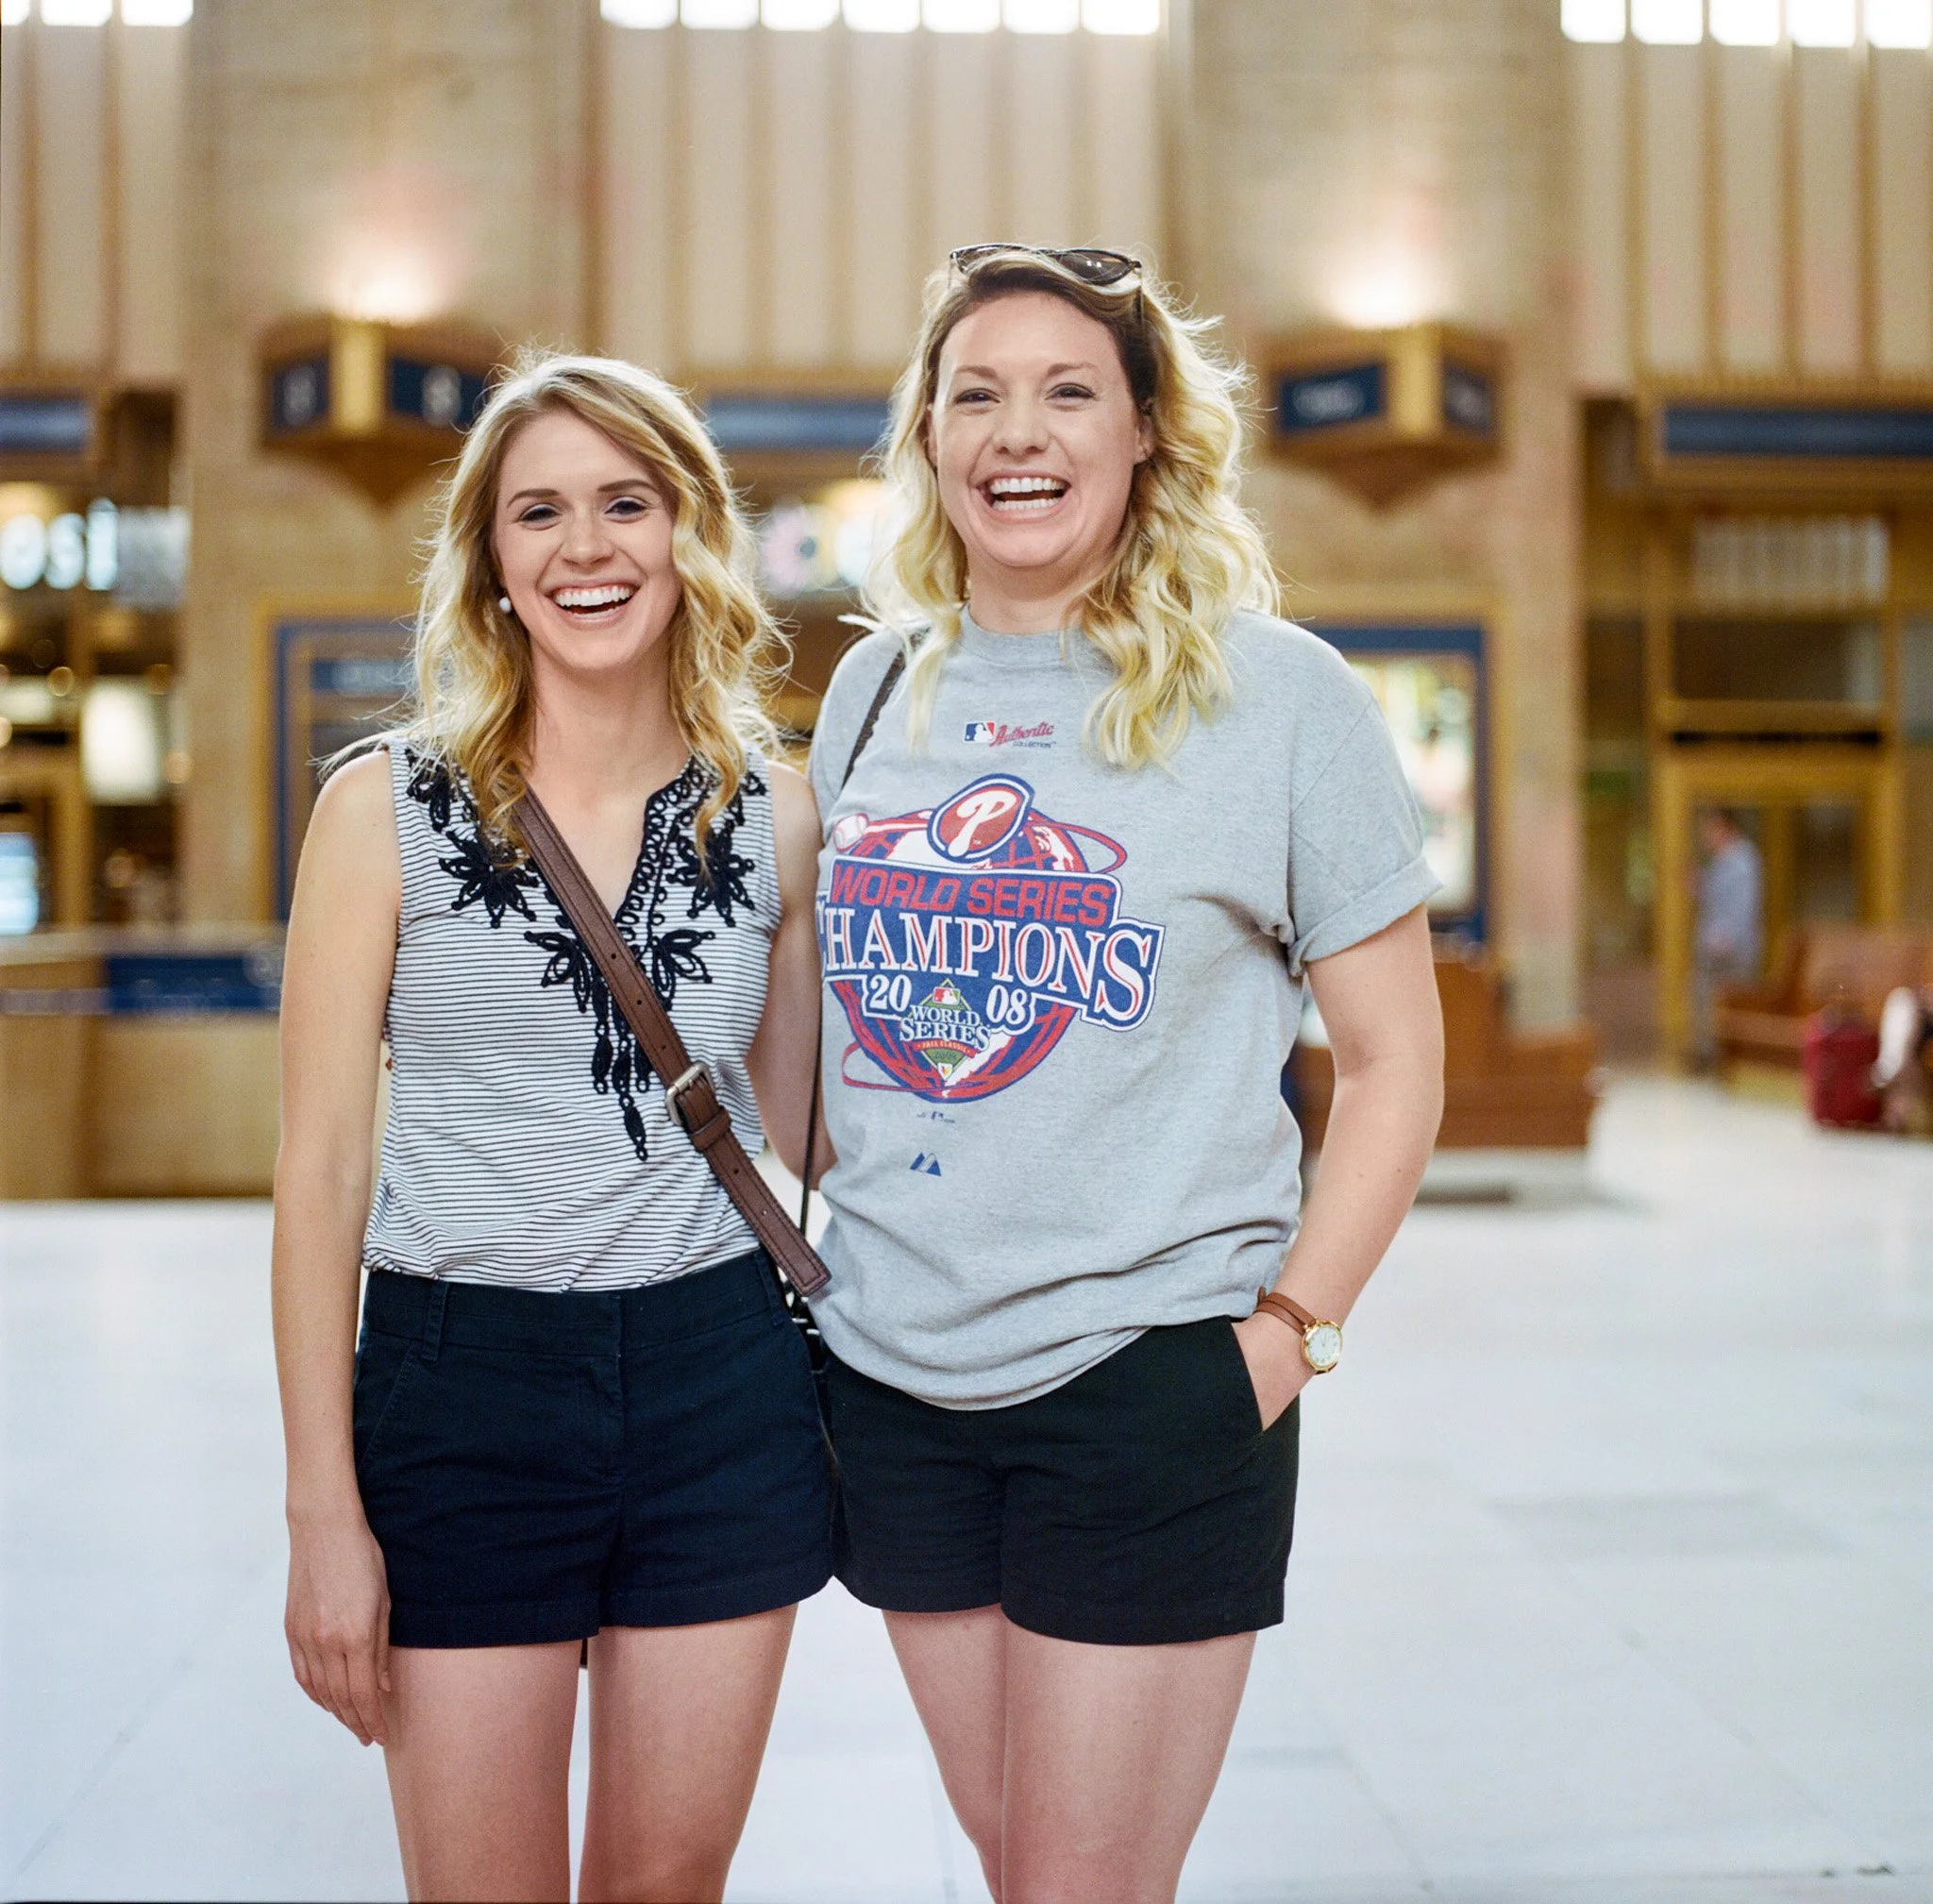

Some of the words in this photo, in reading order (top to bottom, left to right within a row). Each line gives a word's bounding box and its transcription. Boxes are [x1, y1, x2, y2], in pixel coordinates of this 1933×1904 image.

[989, 721, 1054, 747] Authentic
[948, 790, 1017, 857] P
[831, 864, 962, 911] WORLD
[966, 878, 1111, 926] SERIES
[869, 974, 912, 1012] 20
[986, 985, 1027, 1024] 08
[910, 1004, 981, 1026] WORLD
[899, 1018, 991, 1052] SERIES
